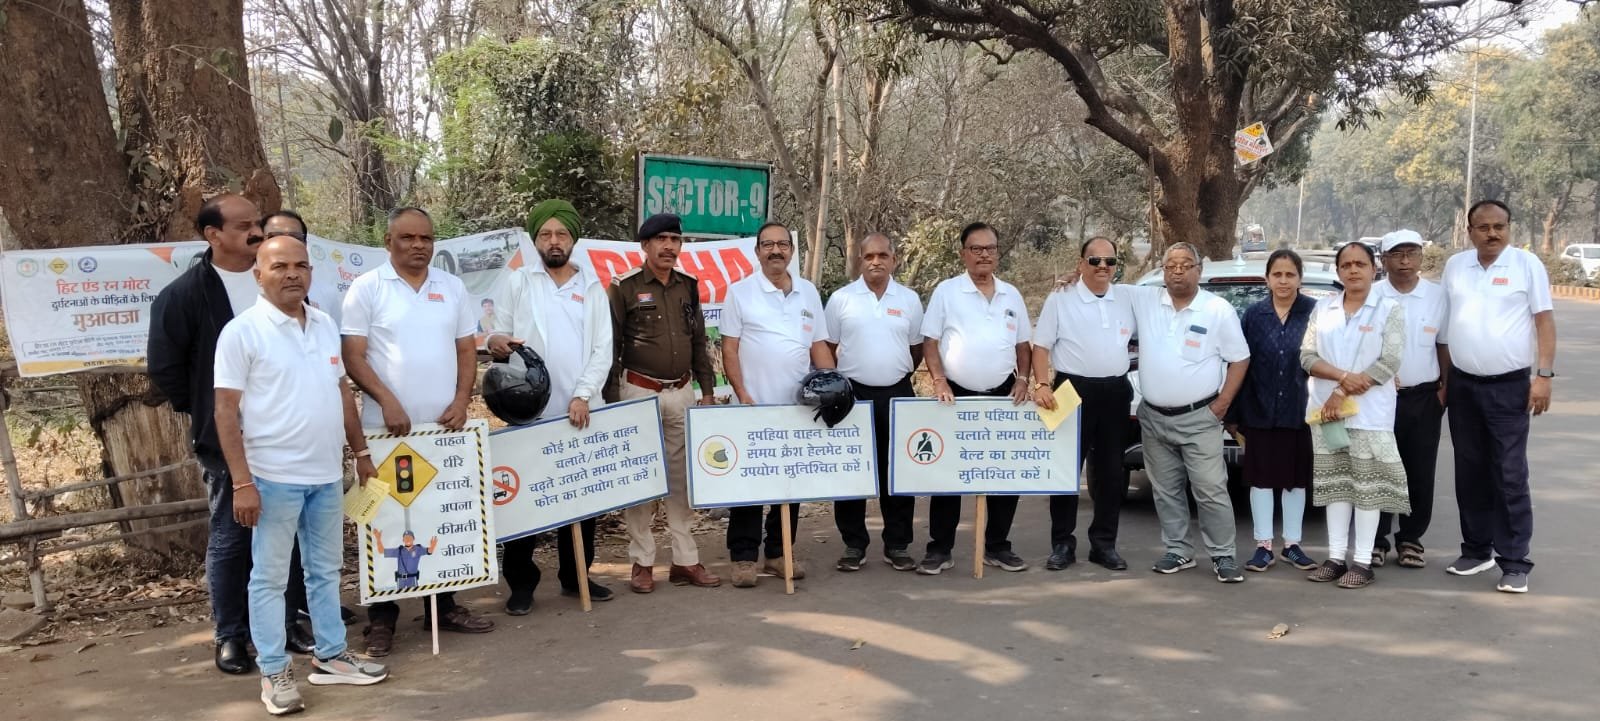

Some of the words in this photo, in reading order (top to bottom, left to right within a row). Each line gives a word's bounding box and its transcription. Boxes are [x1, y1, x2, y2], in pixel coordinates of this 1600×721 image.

[647, 175, 764, 219] SECTOR-9
[587, 247, 754, 304] DHA
[56, 278, 79, 295] हिट
[82, 279, 100, 292] एंड
[103, 280, 119, 291] रन
[122, 276, 151, 290] मोटर
[90, 296, 100, 306] के
[130, 292, 140, 304] के
[71, 309, 140, 332] मुआवजा
[704, 308, 723, 321] हमा
[956, 410, 980, 421] चार
[984, 408, 1019, 422] पहिया
[1023, 410, 1042, 422] वा
[434, 435, 466, 447] वाहन
[542, 440, 565, 456] कोई
[568, 436, 580, 449] भी
[583, 431, 609, 445] व्यक्ति
[613, 425, 639, 438] वाहन
[747, 427, 788, 447] दुपहिया
[793, 429, 822, 440] वाहन
[827, 424, 860, 438] चलाते
[955, 426, 991, 441] चलाते
[996, 430, 1026, 441] समय
[1031, 428, 1056, 441] सीट
[622, 440, 632, 452] में
[747, 449, 776, 459] समय
[781, 444, 803, 458] क्रैश
[807, 442, 842, 457] हेलमेट
[846, 444, 863, 456] का
[959, 446, 985, 461] बेल्ट
[988, 450, 1006, 460] का
[1010, 446, 1051, 461] उपयोग
[443, 454, 464, 468] धीरे
[558, 467, 589, 486] उतरते
[591, 463, 618, 477] समय
[620, 452, 658, 469] मोबाइल
[740, 462, 779, 478] उपयोग
[784, 461, 838, 479] सुनिश्चित
[842, 458, 861, 473] करें
[958, 467, 1015, 484] सुनिश्चित
[1020, 466, 1041, 480] करें
[533, 494, 559, 508] फोन
[562, 488, 578, 501] का
[580, 479, 615, 497] उपयोग
[617, 475, 630, 486] ना
[633, 466, 649, 482] करें
[440, 500, 473, 513] अपना
[437, 518, 478, 535] कीमती
[440, 543, 475, 557] जीवन
